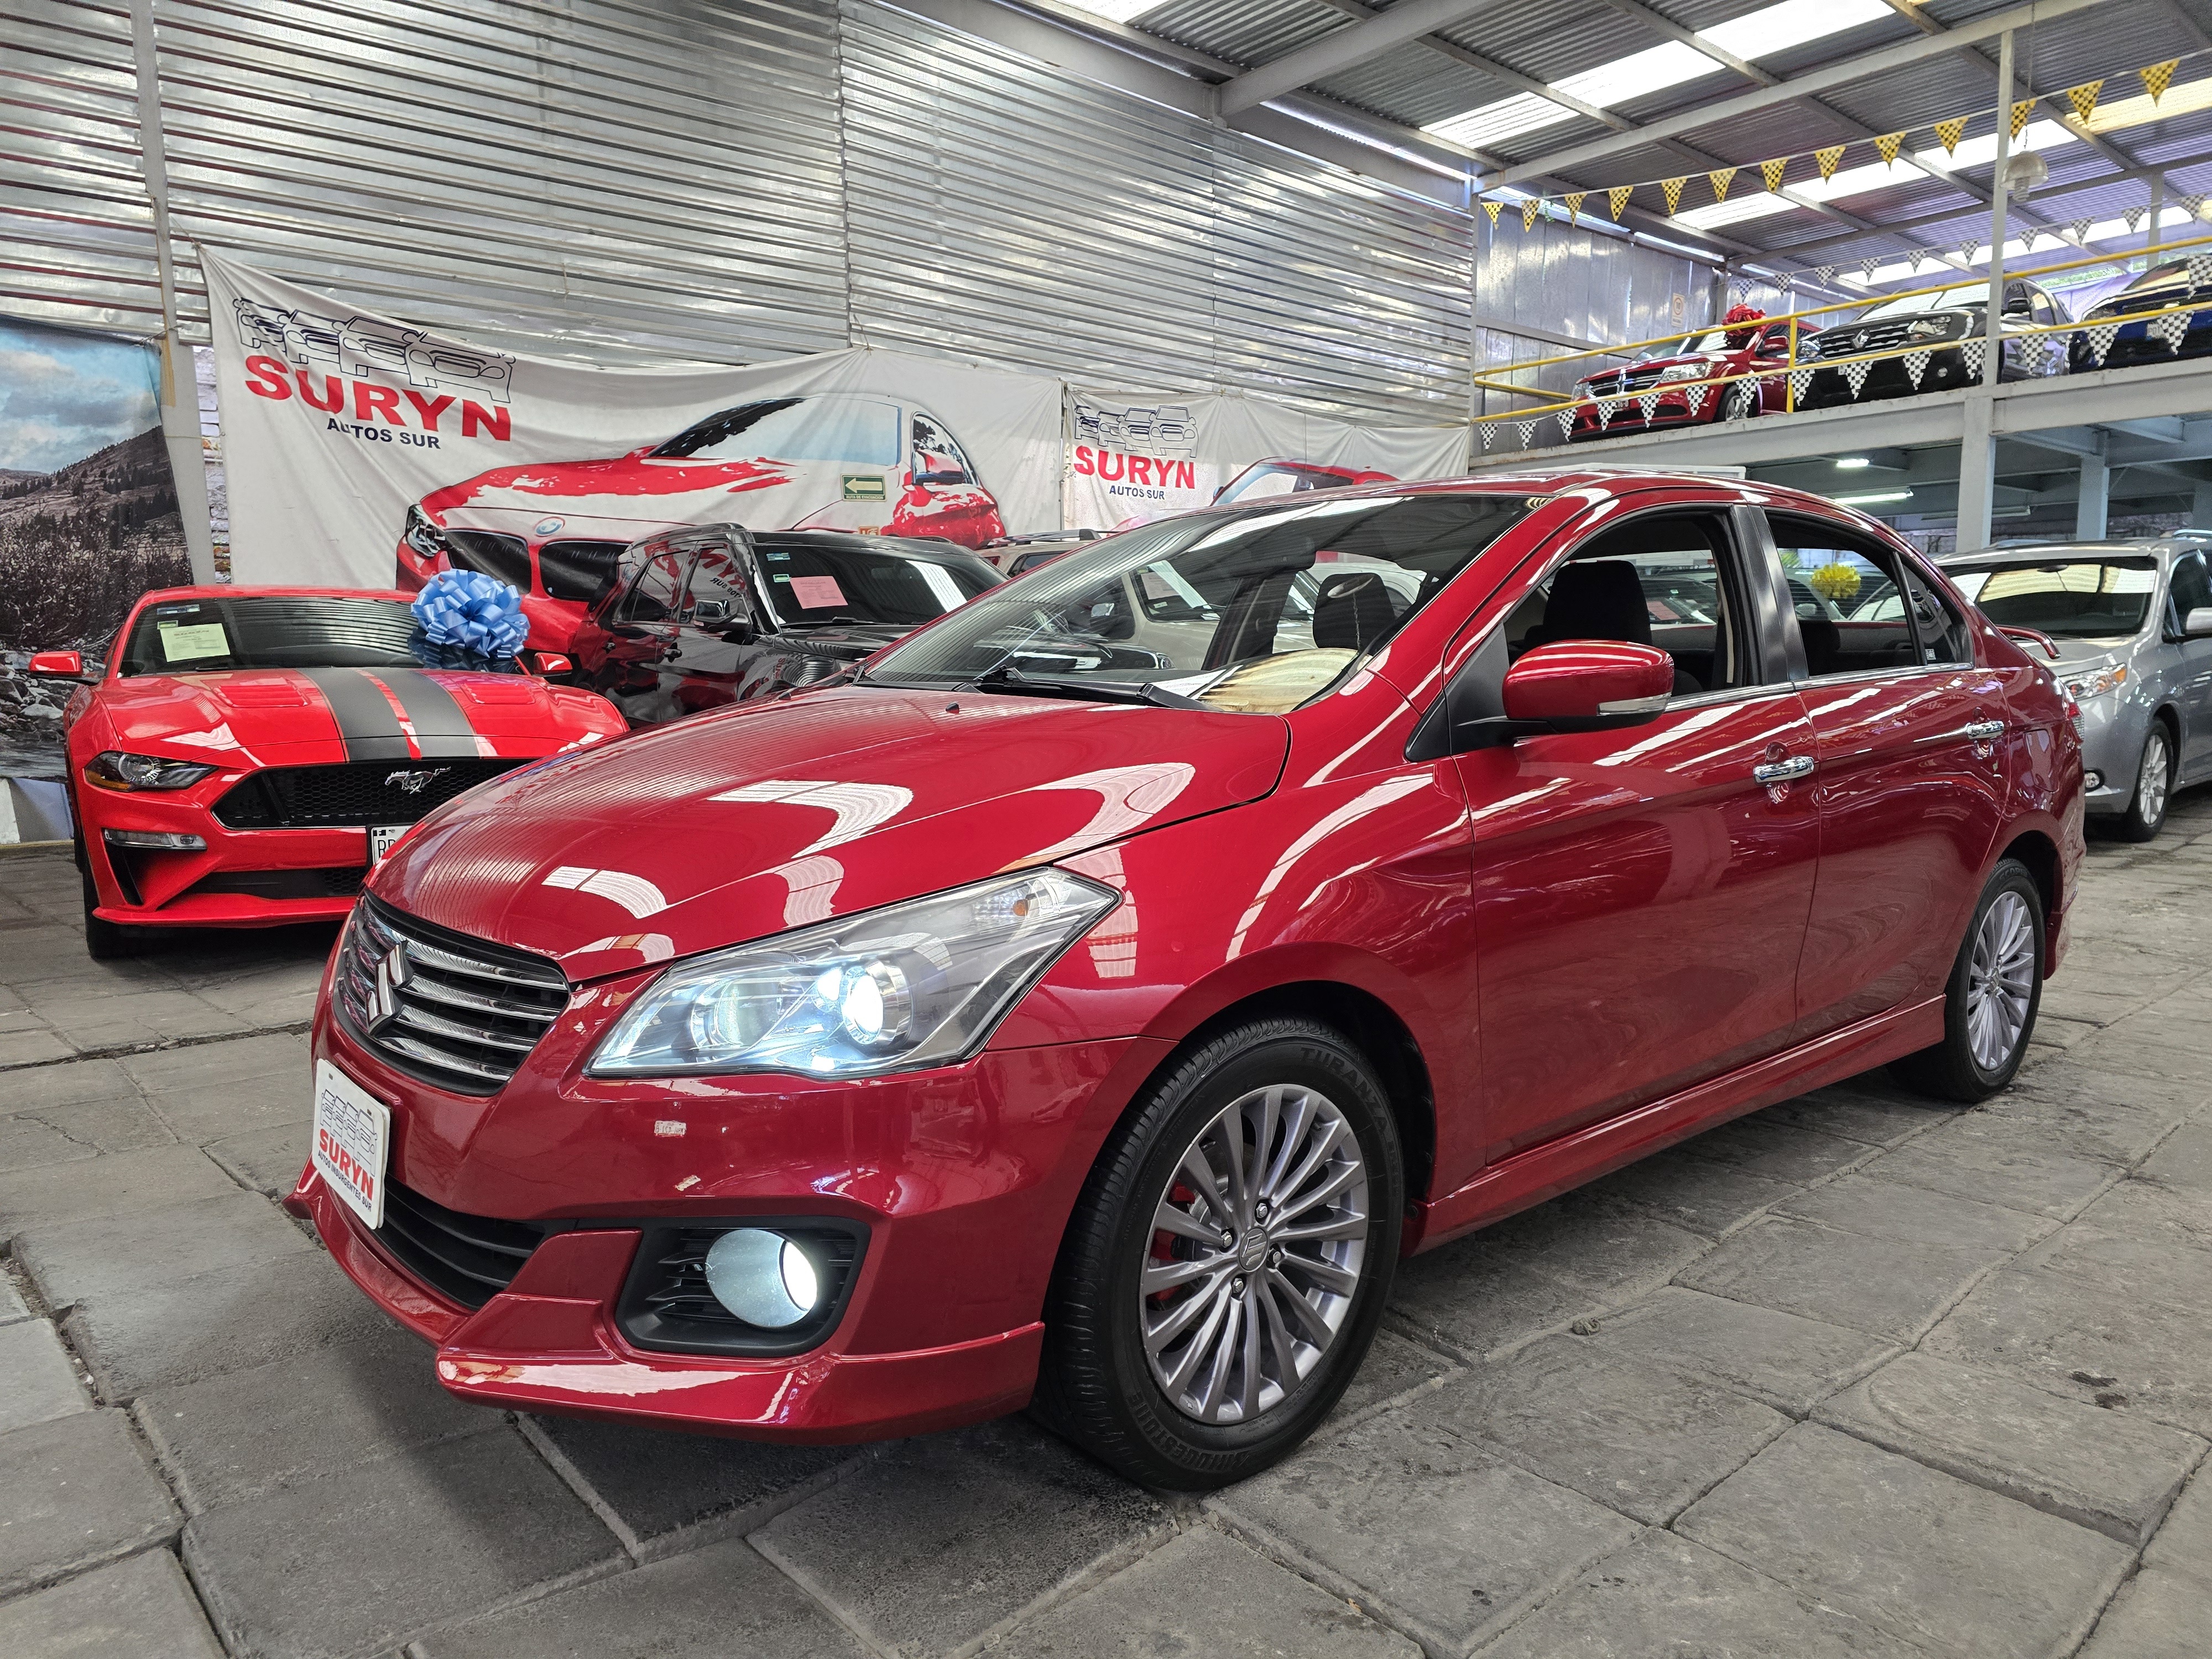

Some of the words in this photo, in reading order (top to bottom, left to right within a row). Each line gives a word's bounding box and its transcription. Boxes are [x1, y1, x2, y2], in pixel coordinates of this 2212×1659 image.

[245, 355, 511, 441] SURYN
[327, 418, 393, 442] AUTOS
[399, 432, 441, 449] SUR
[1073, 445, 1195, 489] SURYN
[1109, 485, 1145, 498] AUTOS
[1147, 489, 1165, 500] SUR
[318, 1150, 331, 1168] AUTOS
[331, 1164, 361, 1201] INSURGENTES
[362, 1196, 372, 1212] SUR
[319, 1128, 374, 1201] SURYN
